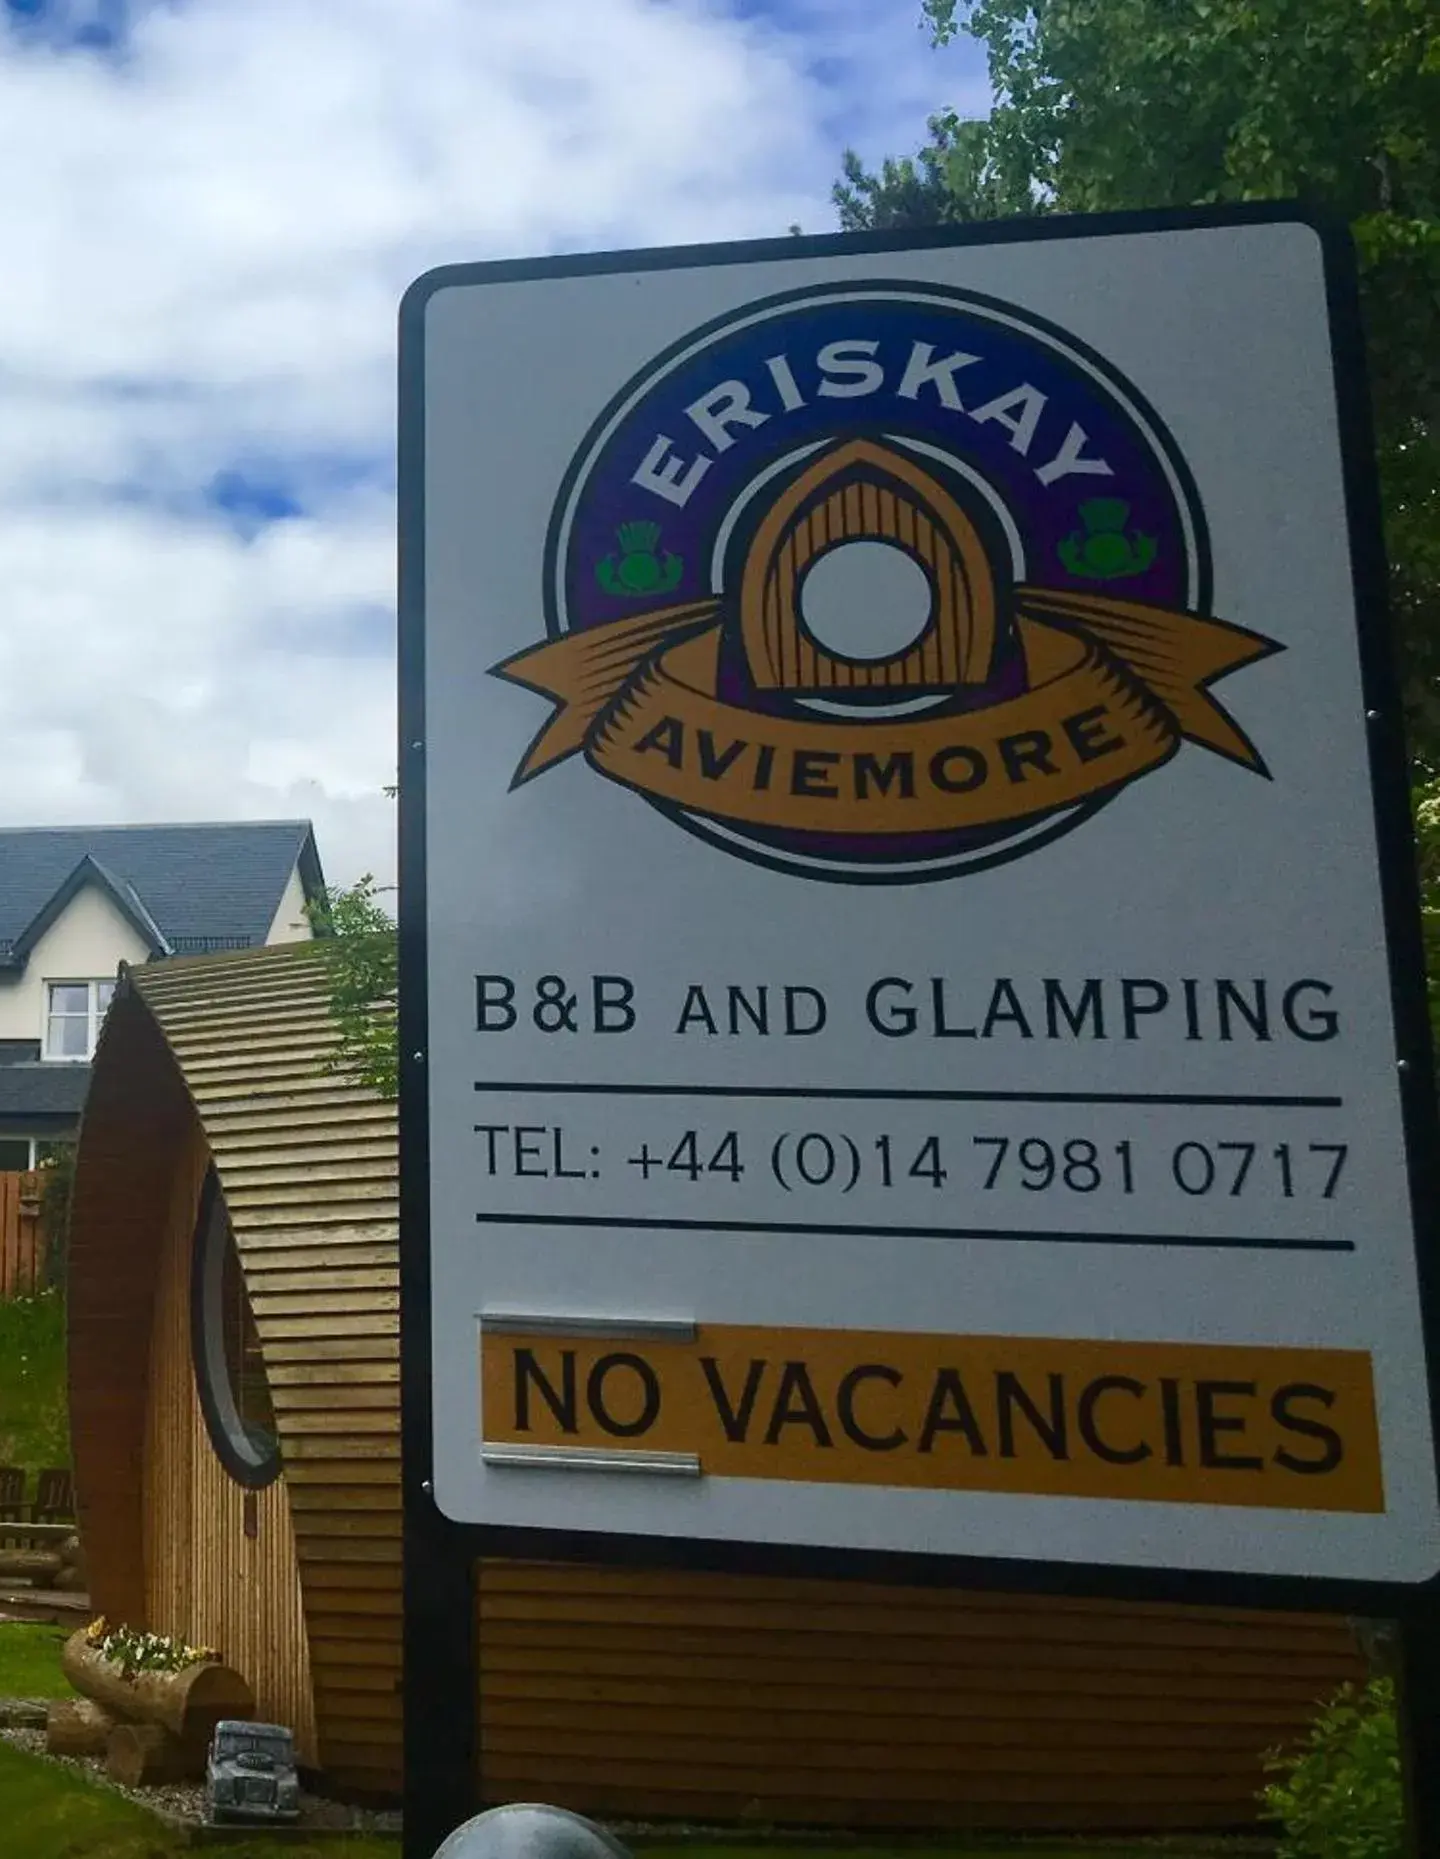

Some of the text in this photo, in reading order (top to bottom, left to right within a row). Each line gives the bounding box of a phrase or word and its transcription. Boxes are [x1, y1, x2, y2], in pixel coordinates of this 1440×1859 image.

[631, 339, 1114, 508] ERISKAY
[635, 706, 1126, 800] AVIEMORE
[474, 974, 1341, 1042] B&B AND GLAMPING
[474, 1125, 1349, 1200] TEL: +44 (0)14 7981 0717
[512, 1348, 1343, 1475] NO VACANCIES
